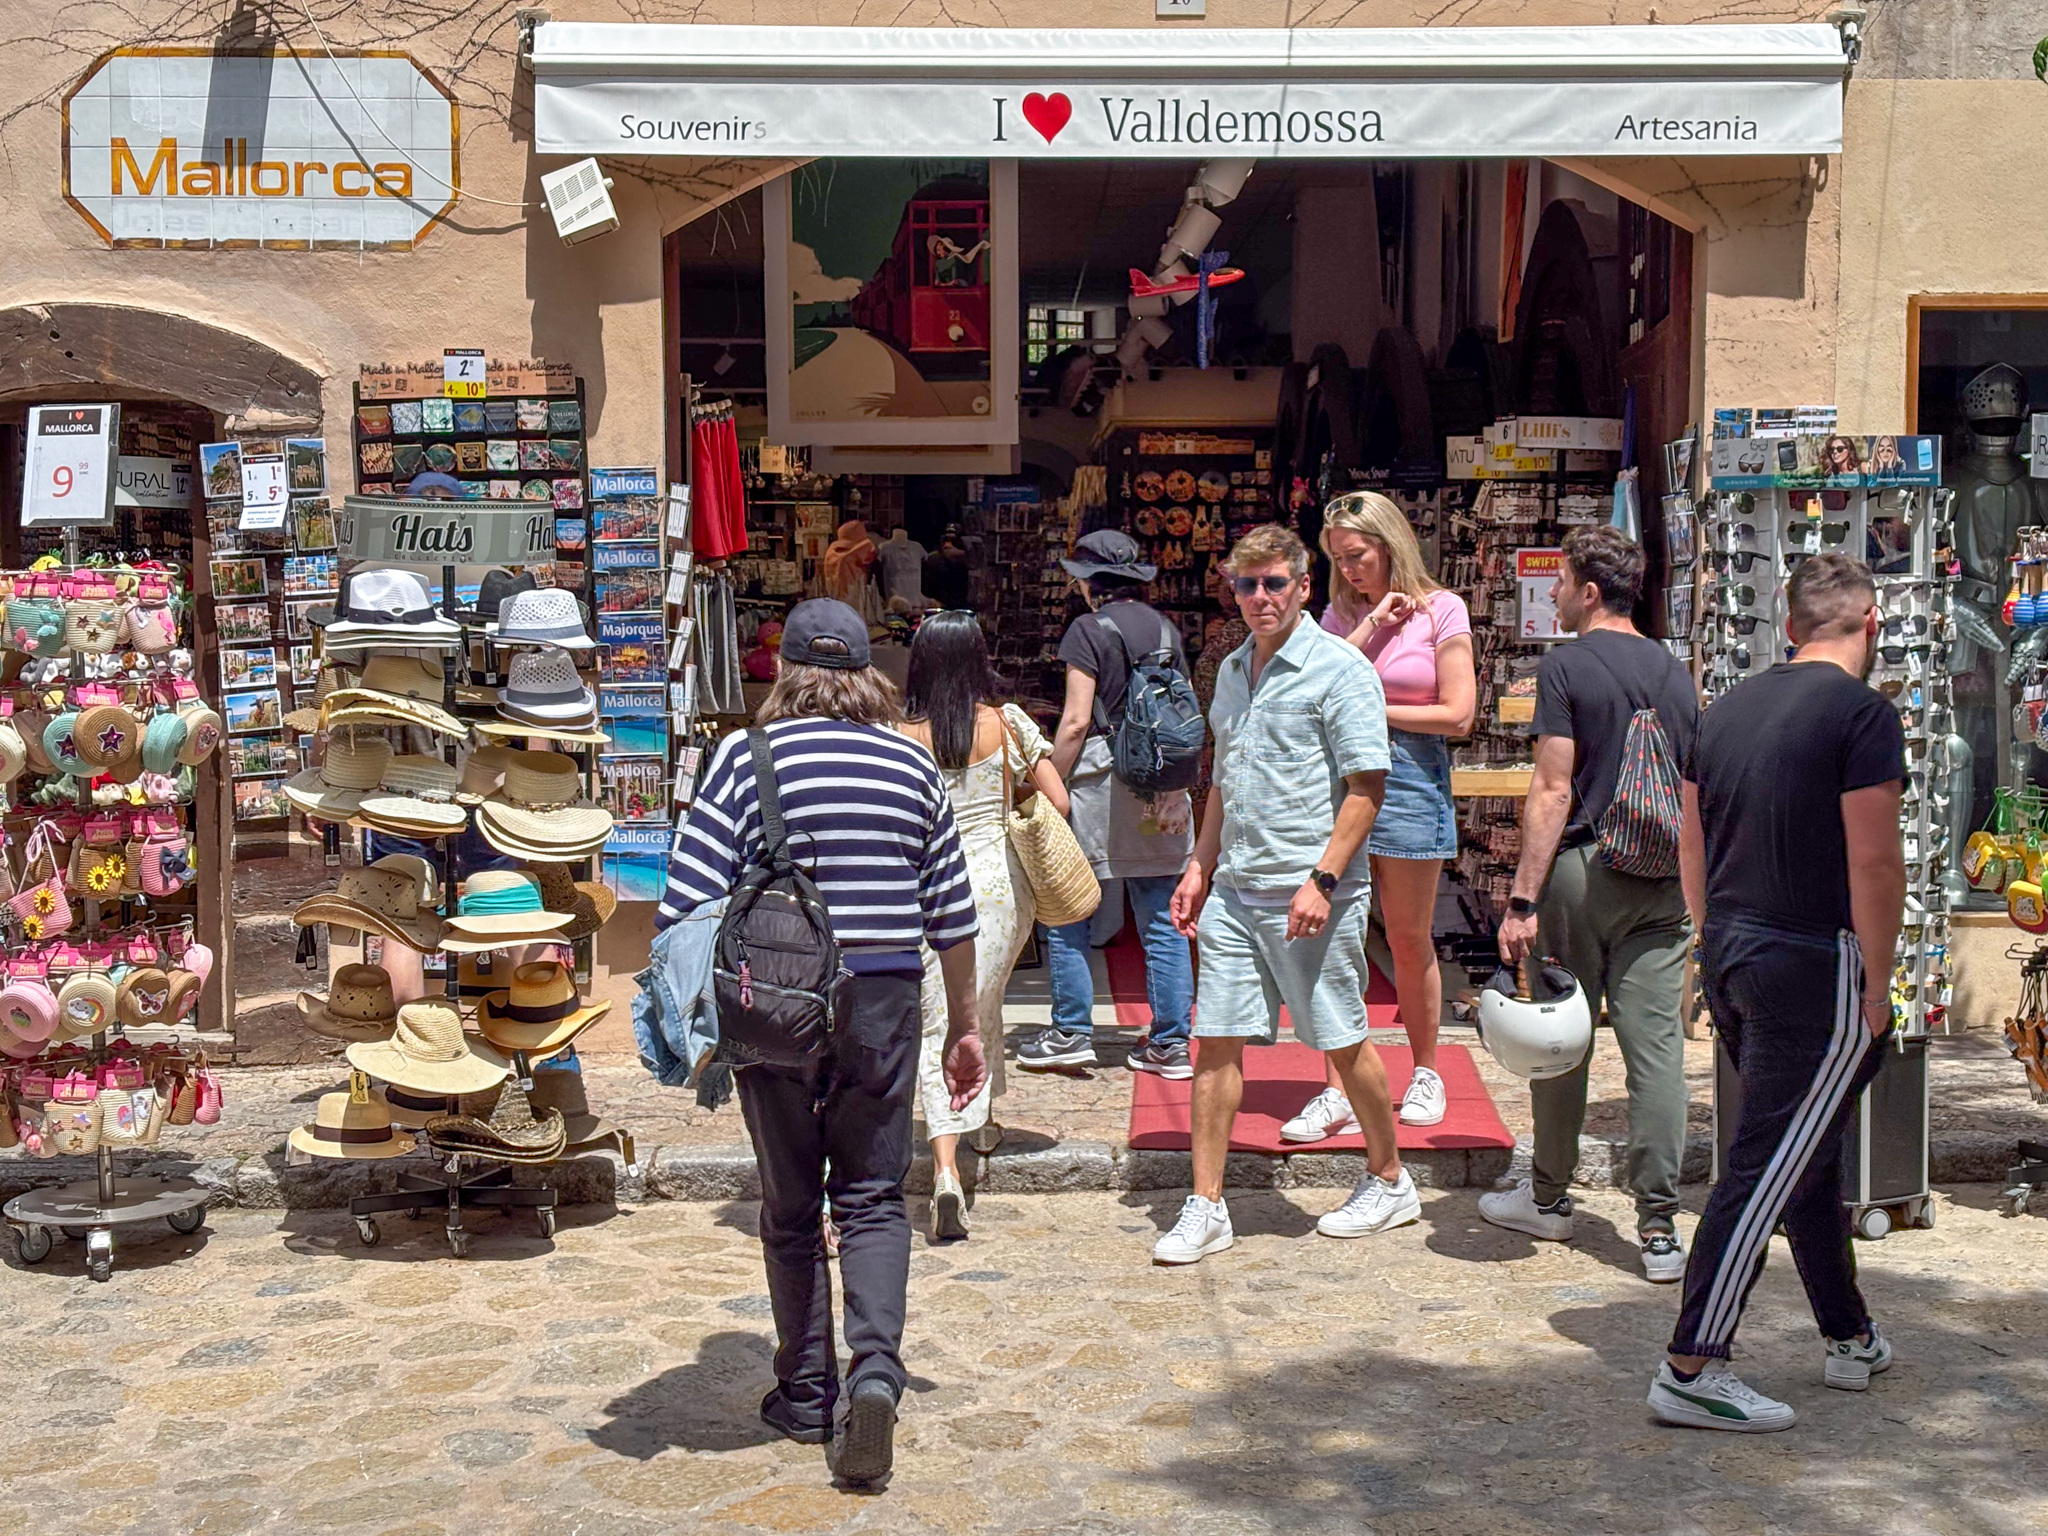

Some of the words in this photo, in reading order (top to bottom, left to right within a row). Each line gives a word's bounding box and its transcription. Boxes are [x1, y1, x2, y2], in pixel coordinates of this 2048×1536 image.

[620, 114, 767, 141] Souvenirs
[992, 98, 1008, 142] I
[1100, 97, 1385, 144] Valldemossa
[1614, 114, 1758, 141] Artesania
[110, 137, 413, 198] Mallorca
[949, 310, 960, 320] 23
[360, 363, 392, 375] Made
[395, 366, 406, 375] in
[407, 363, 444, 375] Mallor
[459, 360, 469, 376] 2
[519, 360, 573, 372] Mallorca
[447, 385, 454, 395] 4
[465, 383, 478, 396] 10
[45, 424, 94, 433] MALLORCA
[1522, 422, 1571, 439] Lilli's
[1533, 457, 1545, 469] 10
[52, 465, 74, 498] 9
[79, 462, 89, 470] 99
[117, 470, 170, 490] URAL
[596, 477, 655, 492] Mallorca
[247, 490, 254, 501] 5
[268, 486, 278, 501] 5
[392, 514, 473, 552] Hats
[526, 515, 555, 552] Ha
[394, 554, 473, 562] COLLECTIN
[597, 552, 656, 565] Mallorca
[1526, 556, 1564, 567] SWIFTY
[602, 624, 663, 640] Majorque
[1525, 620, 1535, 636] 5
[604, 694, 662, 708] Mallorca
[603, 764, 661, 778] Mallorca
[607, 830, 665, 844] Mallorca
